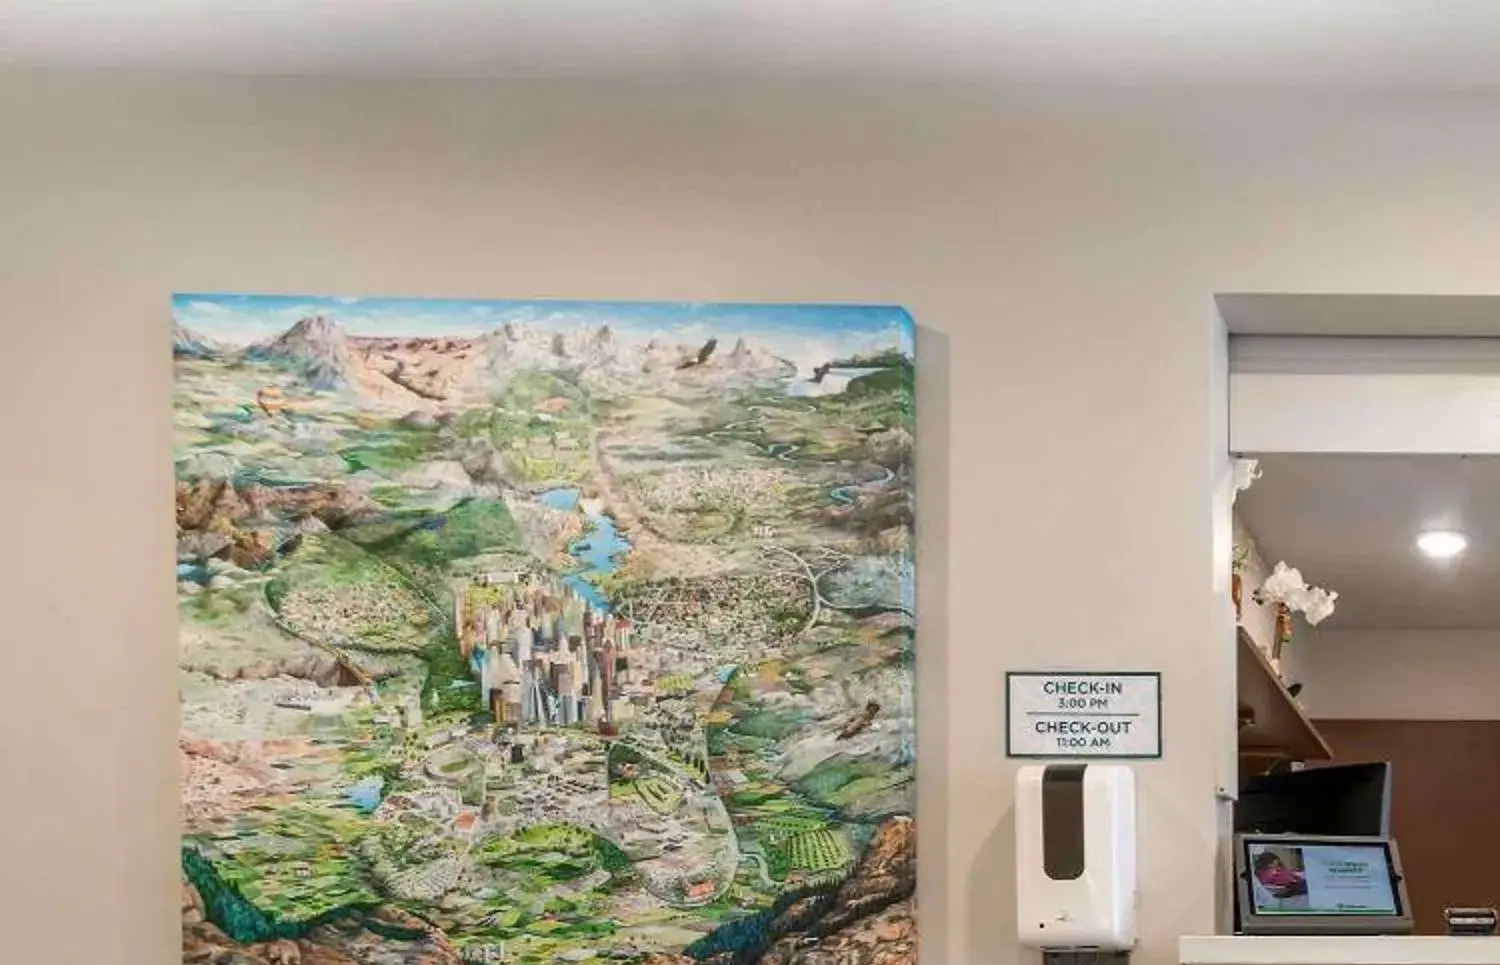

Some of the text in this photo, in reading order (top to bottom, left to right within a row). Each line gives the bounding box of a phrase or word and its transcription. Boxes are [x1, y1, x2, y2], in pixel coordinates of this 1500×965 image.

[1043, 681, 1122, 694] CHECK-IN
[1058, 698, 1109, 709] 3:00 PM
[1035, 721, 1132, 734] CHECK-OUT
[1056, 737, 1111, 748] 11:00 AM
